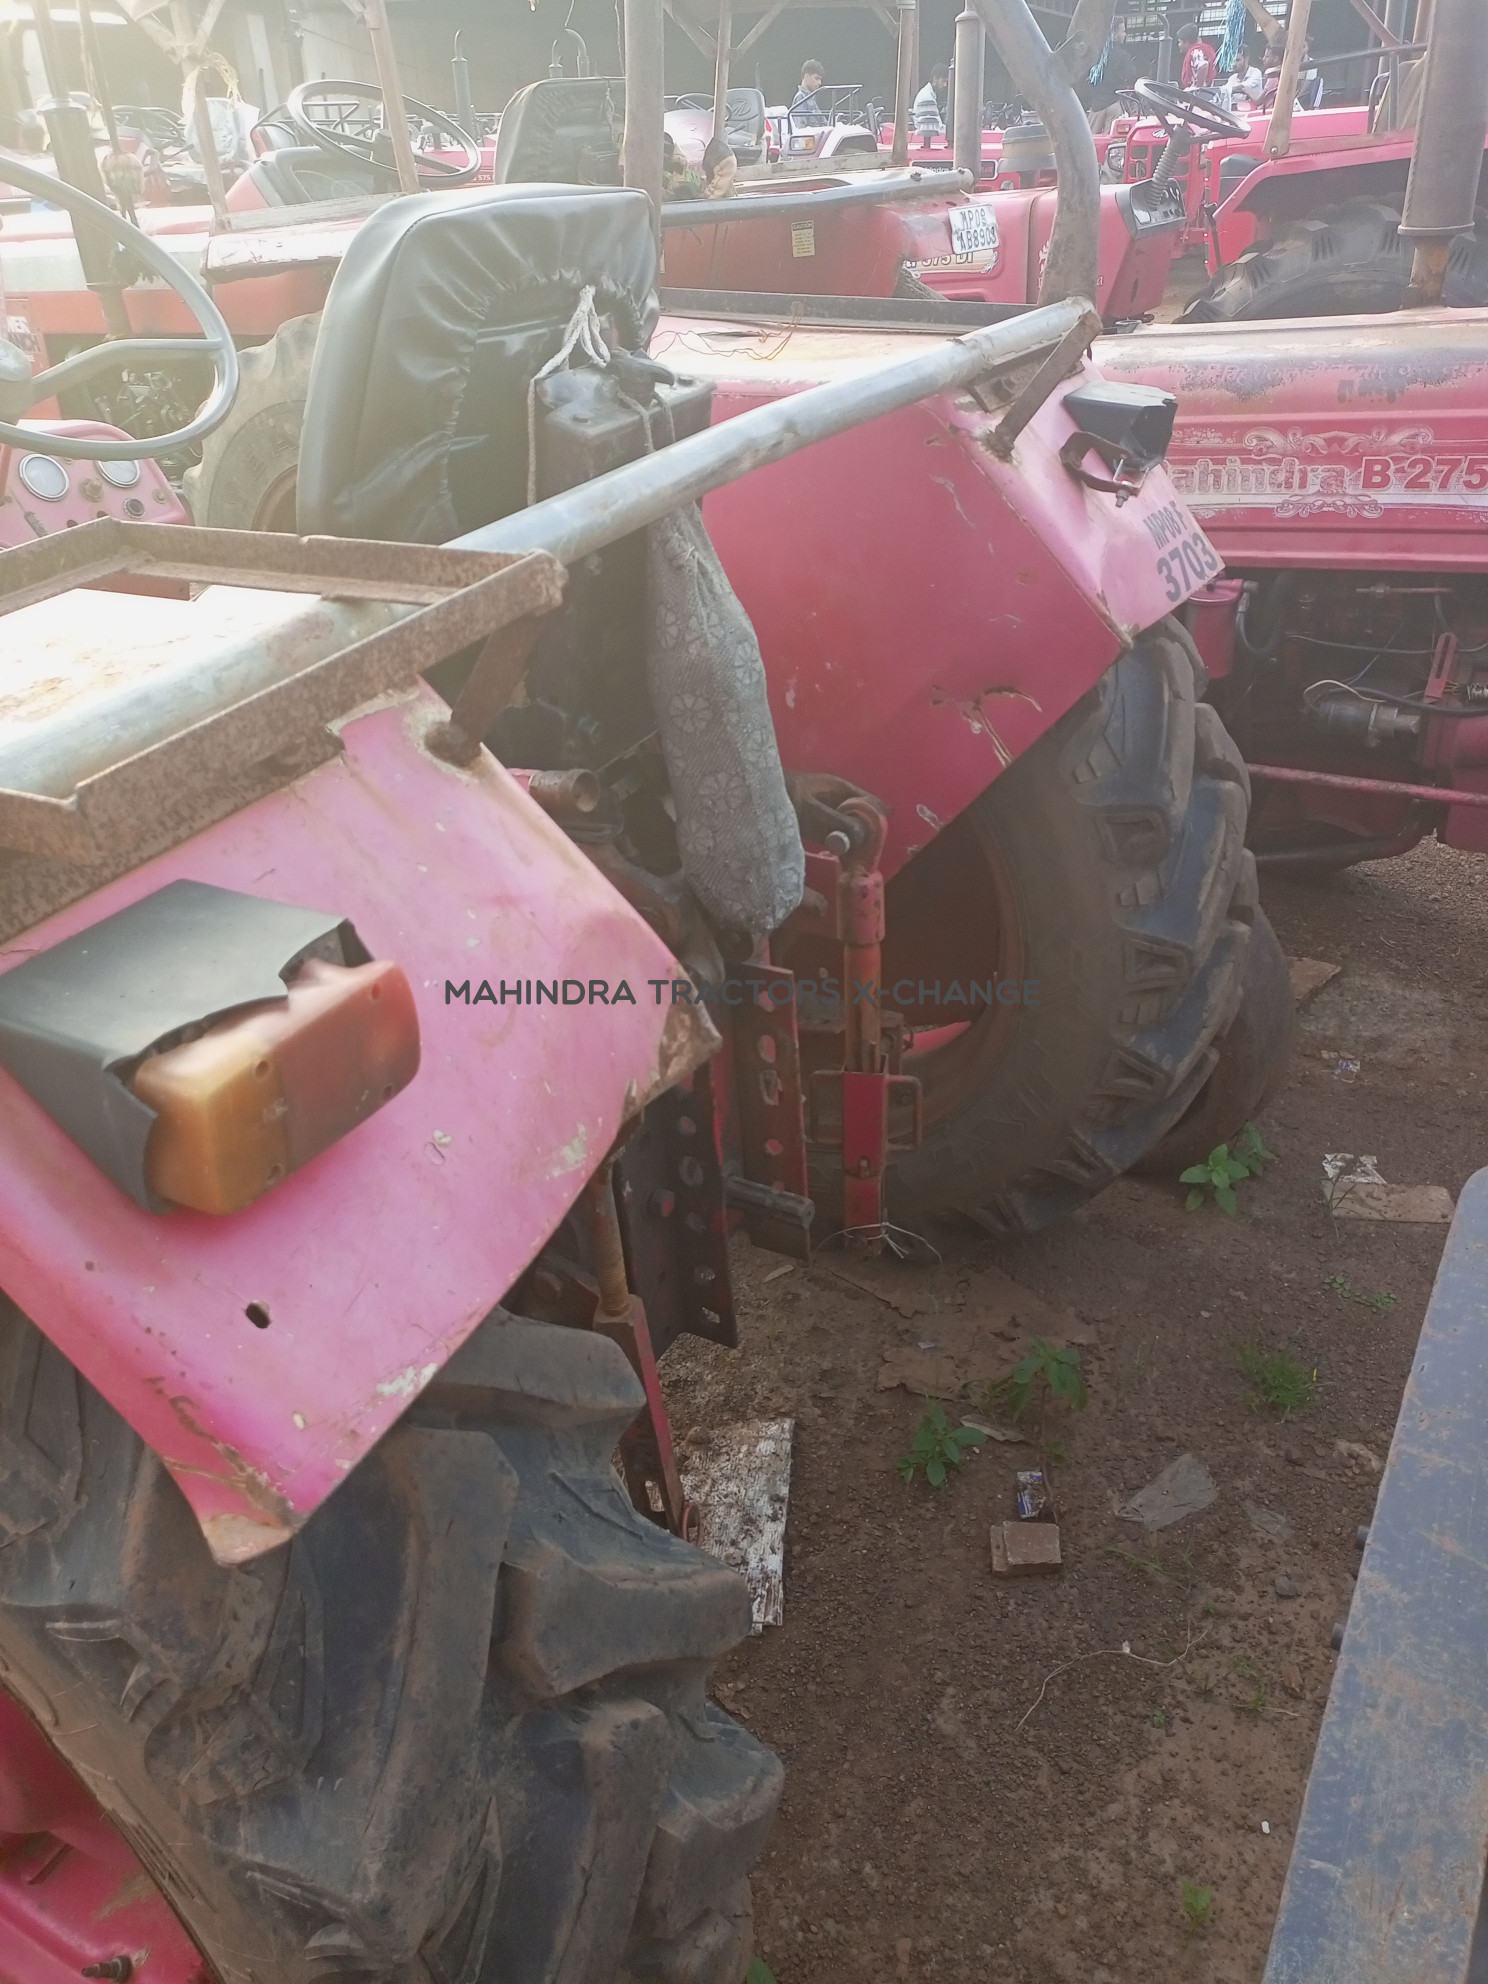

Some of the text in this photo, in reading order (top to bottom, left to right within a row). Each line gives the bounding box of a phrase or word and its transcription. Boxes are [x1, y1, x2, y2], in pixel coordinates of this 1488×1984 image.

[1164, 456, 1488, 493] ahindra B 275
[1156, 531, 1218, 603] 3703
